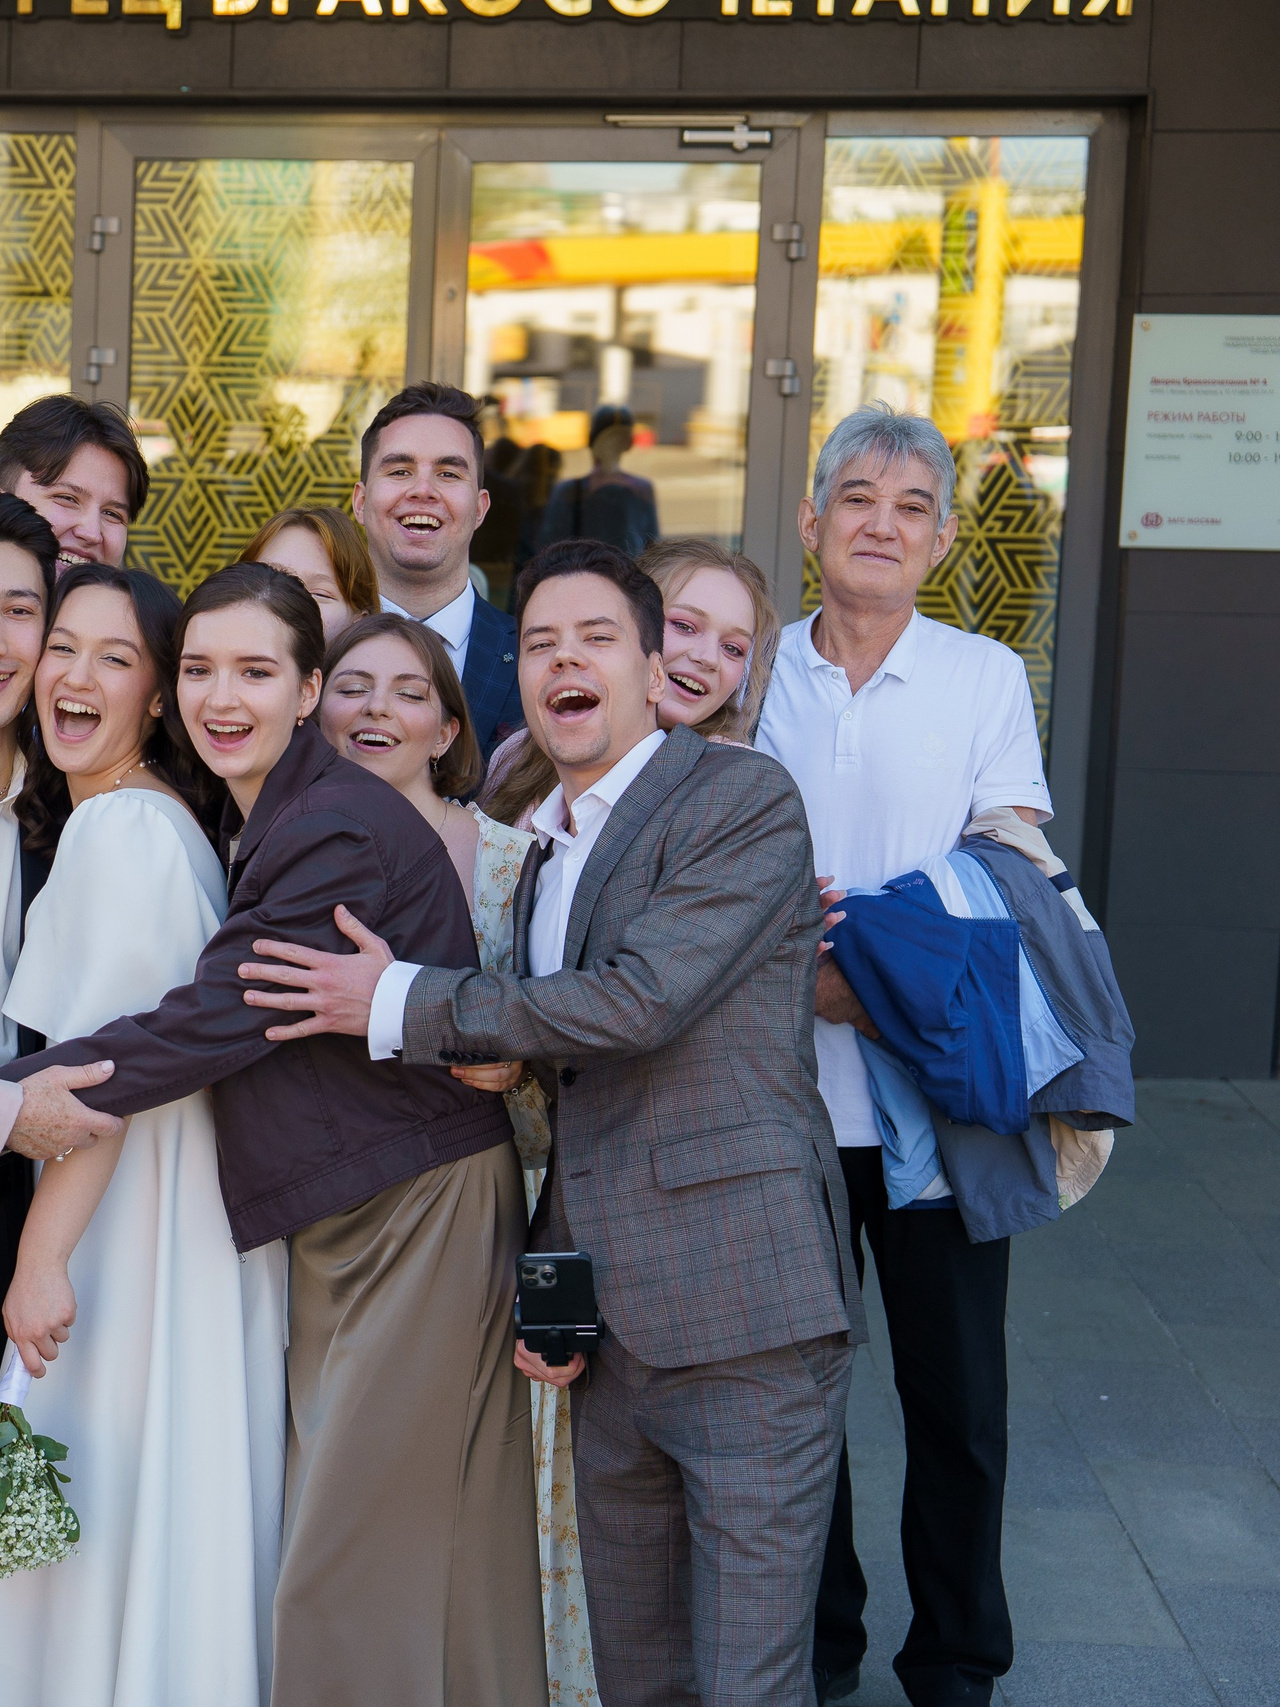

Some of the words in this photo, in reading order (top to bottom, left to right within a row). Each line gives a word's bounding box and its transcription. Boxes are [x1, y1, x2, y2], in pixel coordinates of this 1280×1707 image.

[1150, 376, 1181, 386] Дворец
[1147, 410, 1194, 422] РЕЖИМ
[1197, 411, 1247, 424] РАБОТЫ
[1234, 430, 1262, 442] 9:00
[1228, 452, 1261, 463] 10:00
